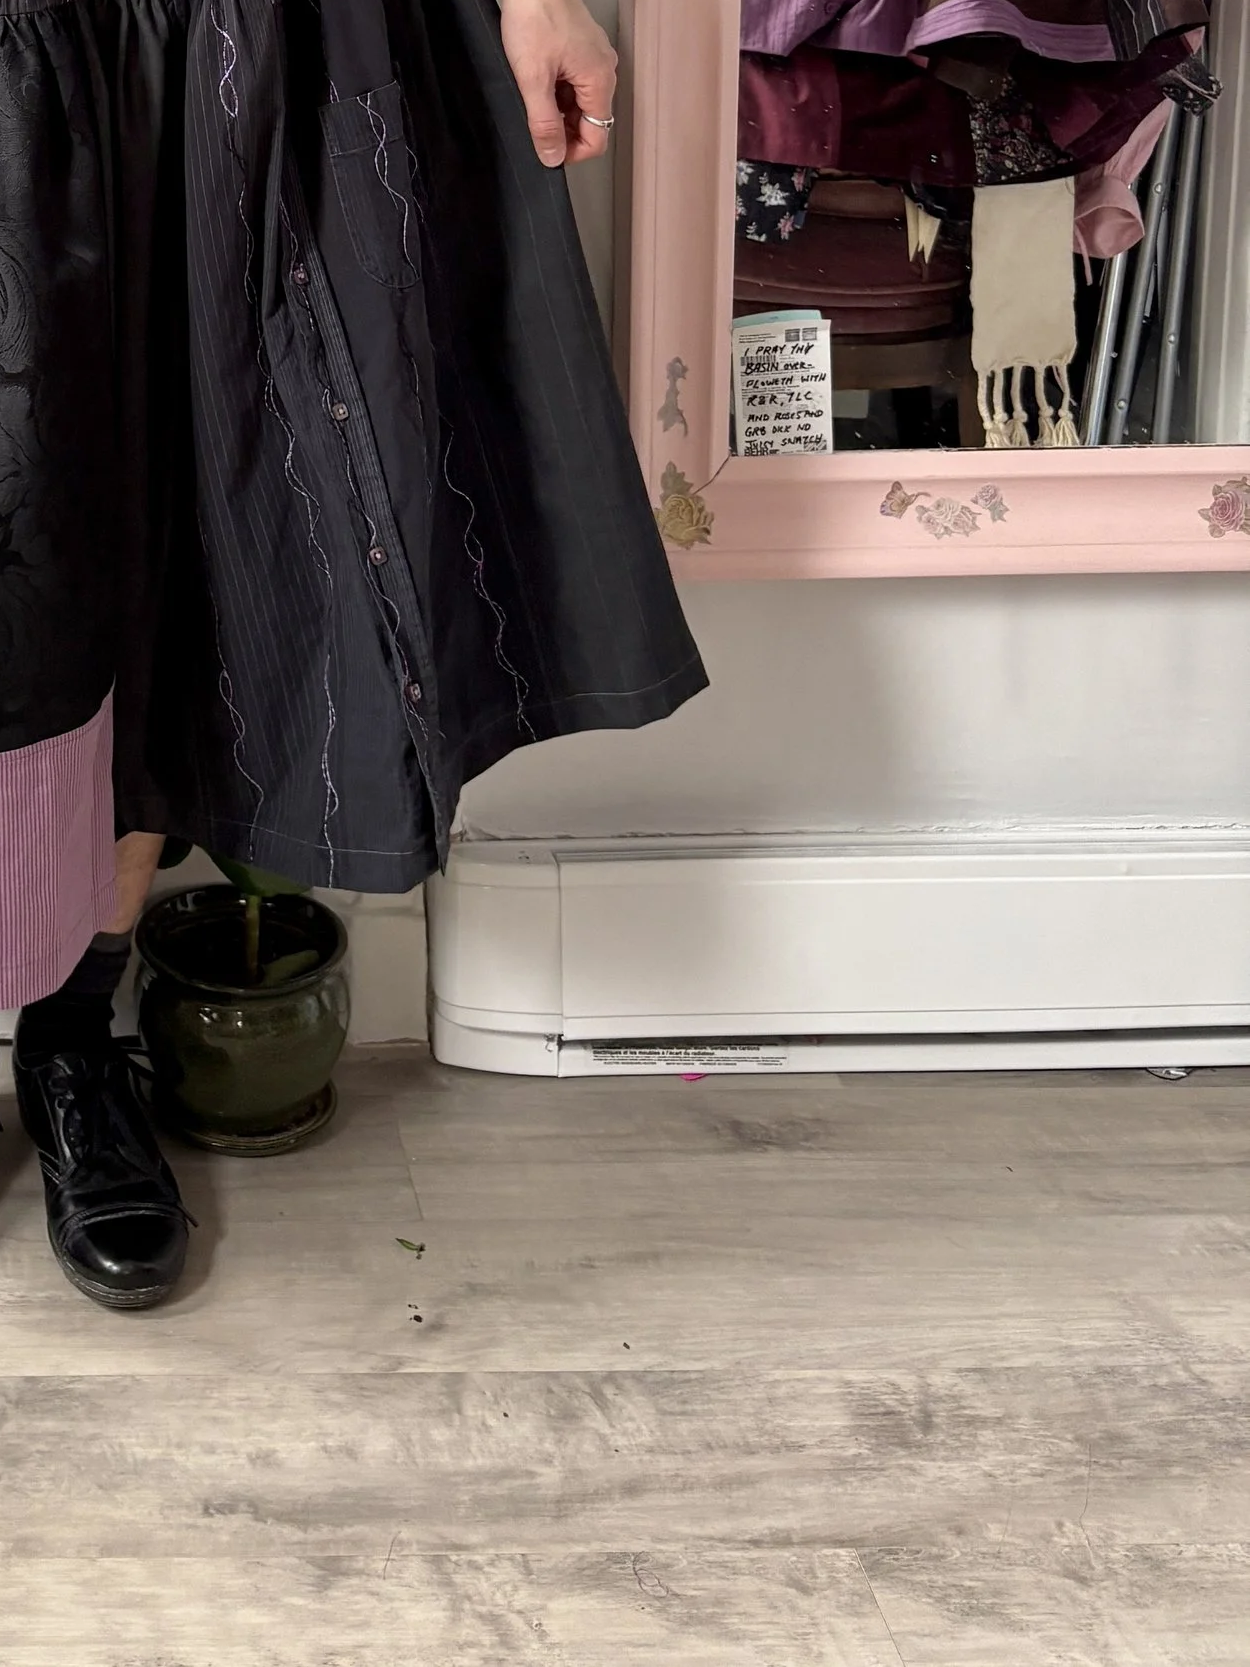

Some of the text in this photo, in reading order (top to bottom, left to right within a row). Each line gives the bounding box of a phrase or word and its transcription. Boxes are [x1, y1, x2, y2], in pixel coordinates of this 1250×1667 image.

[744, 347, 750, 356] I
[756, 344, 786, 355] PRAY
[745, 362, 779, 375] BASIN
[801, 373, 826, 383] WITH
[786, 391, 812, 402] TLC
[747, 414, 770, 423] AND
[804, 410, 824, 418] AND
[745, 426, 767, 437] GR8
[781, 434, 823, 447] SNATCH
